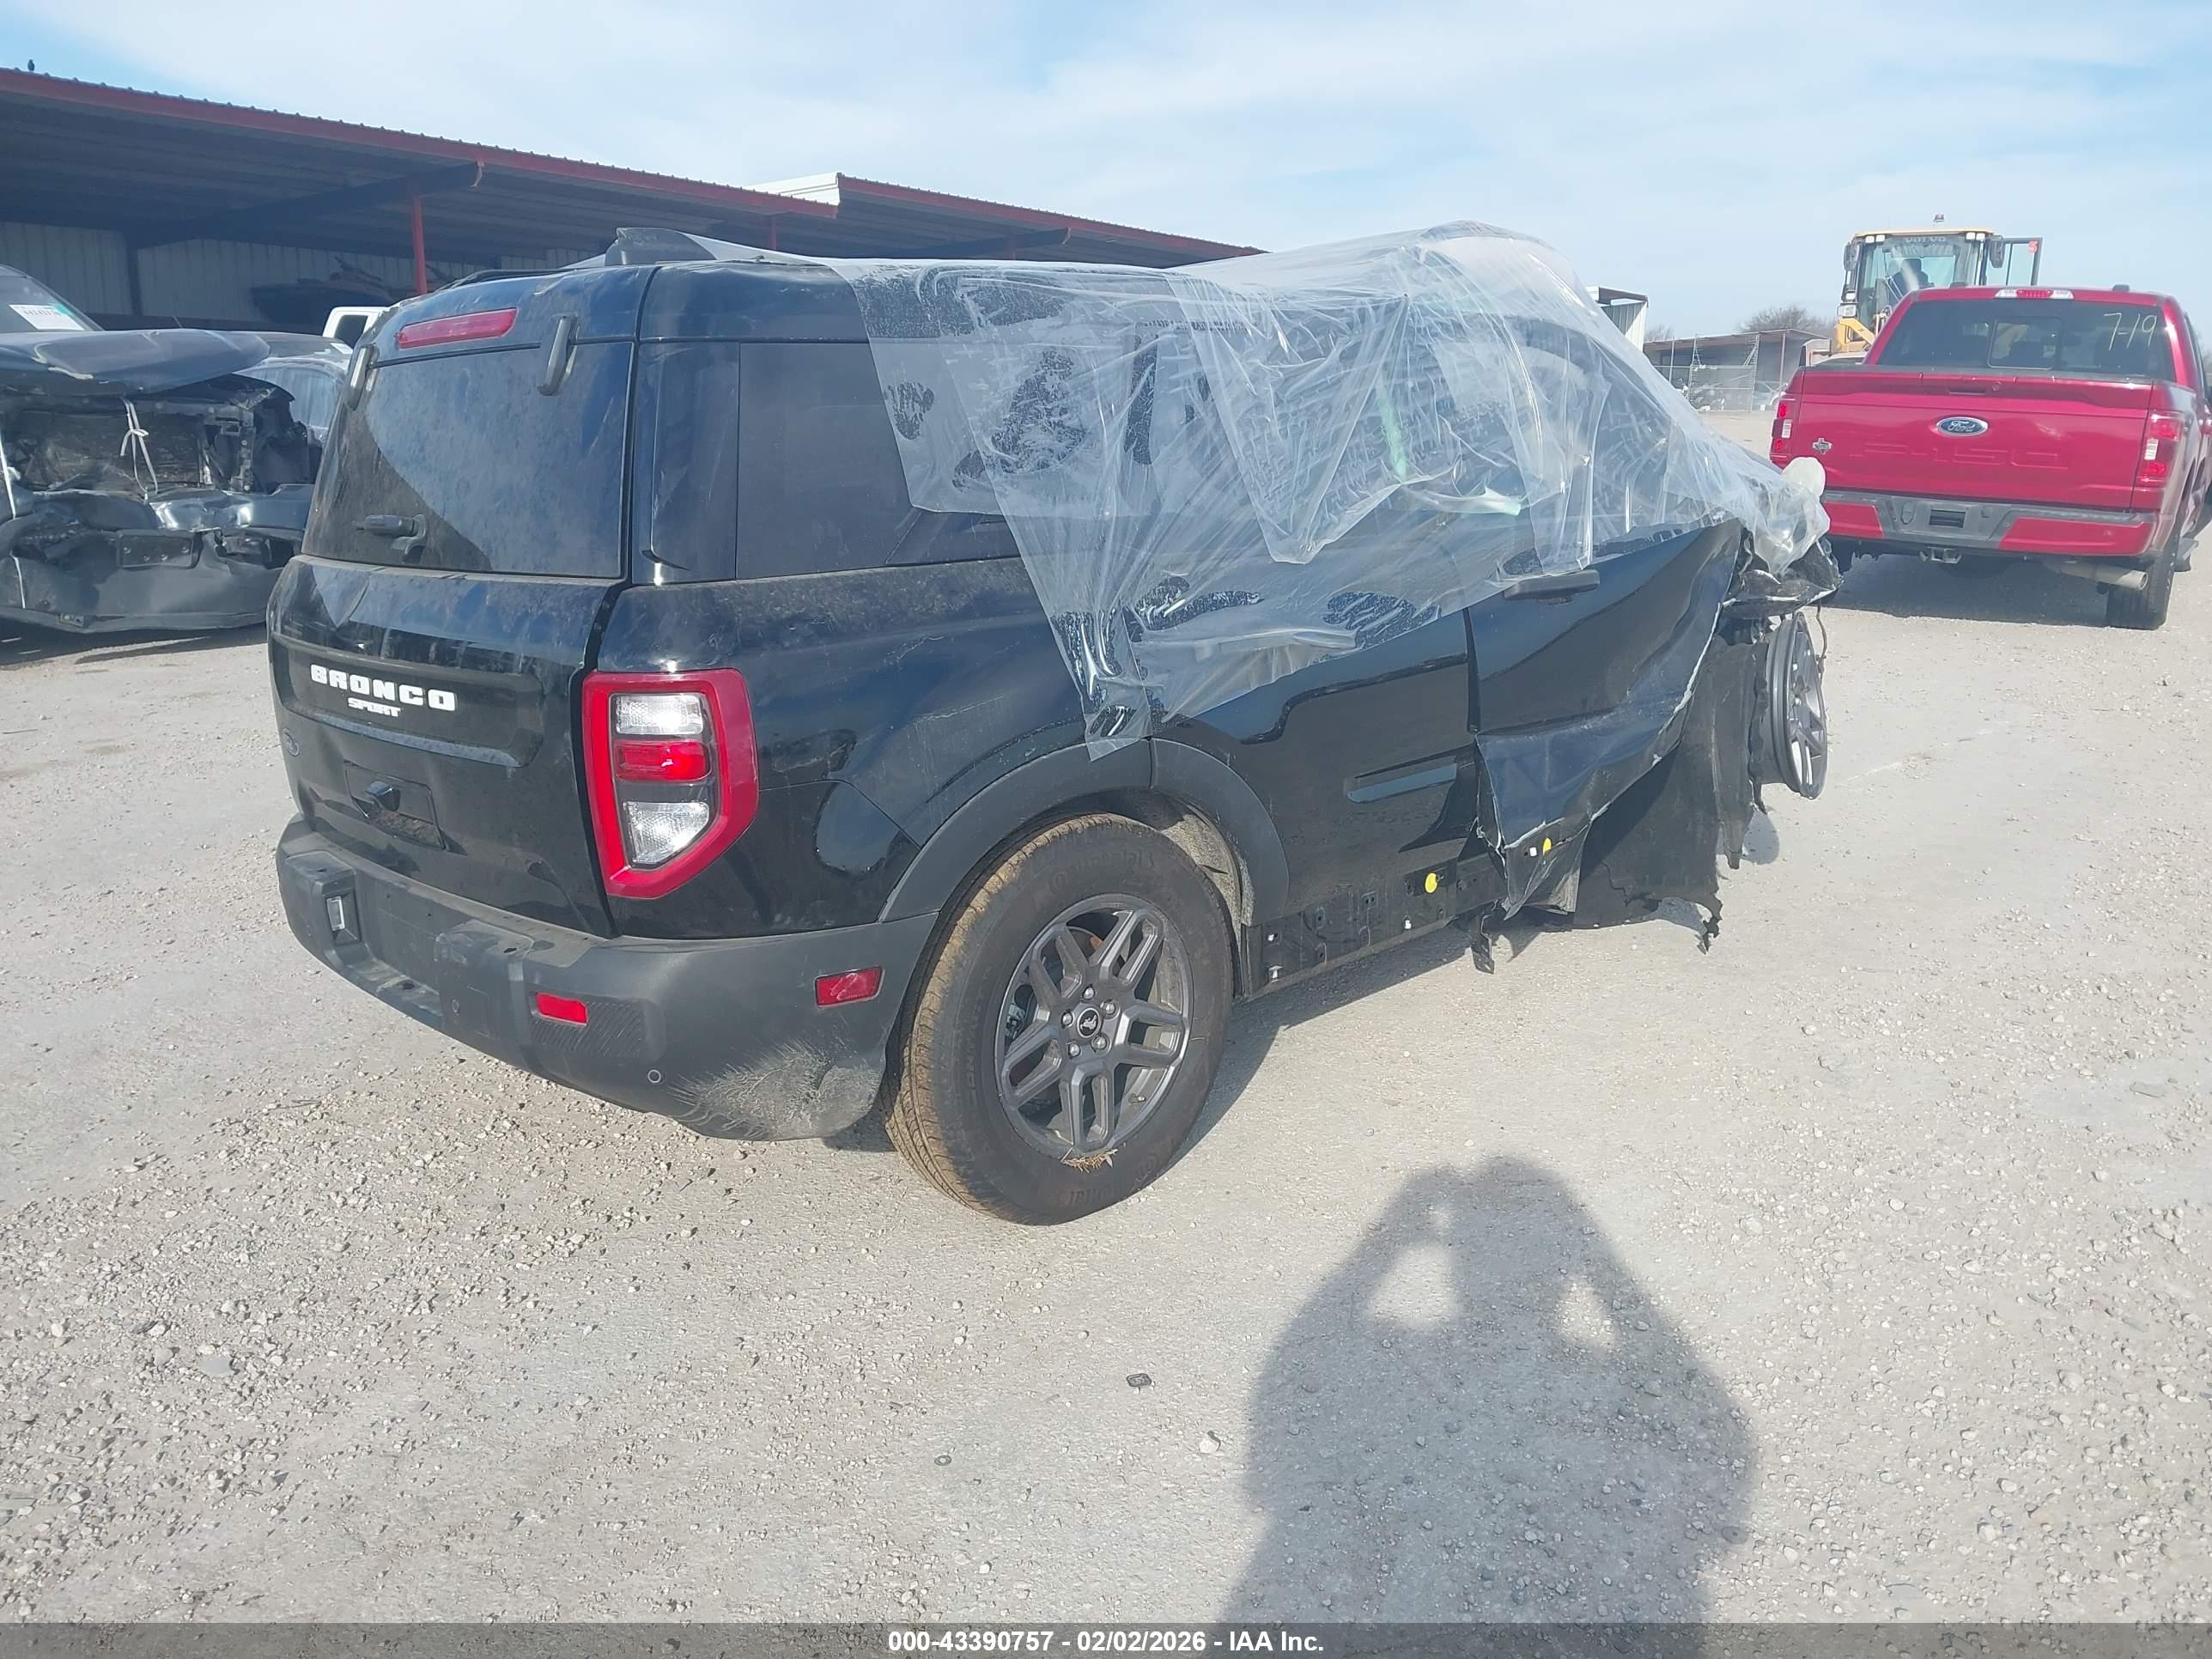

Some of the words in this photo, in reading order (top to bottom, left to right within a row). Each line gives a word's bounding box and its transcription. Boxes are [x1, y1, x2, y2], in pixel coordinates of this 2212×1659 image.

[2103, 313, 2157, 350] 7-19
[1948, 421, 1976, 433] Ford
[310, 664, 456, 711] BRONCO
[347, 697, 401, 717] SPORT
